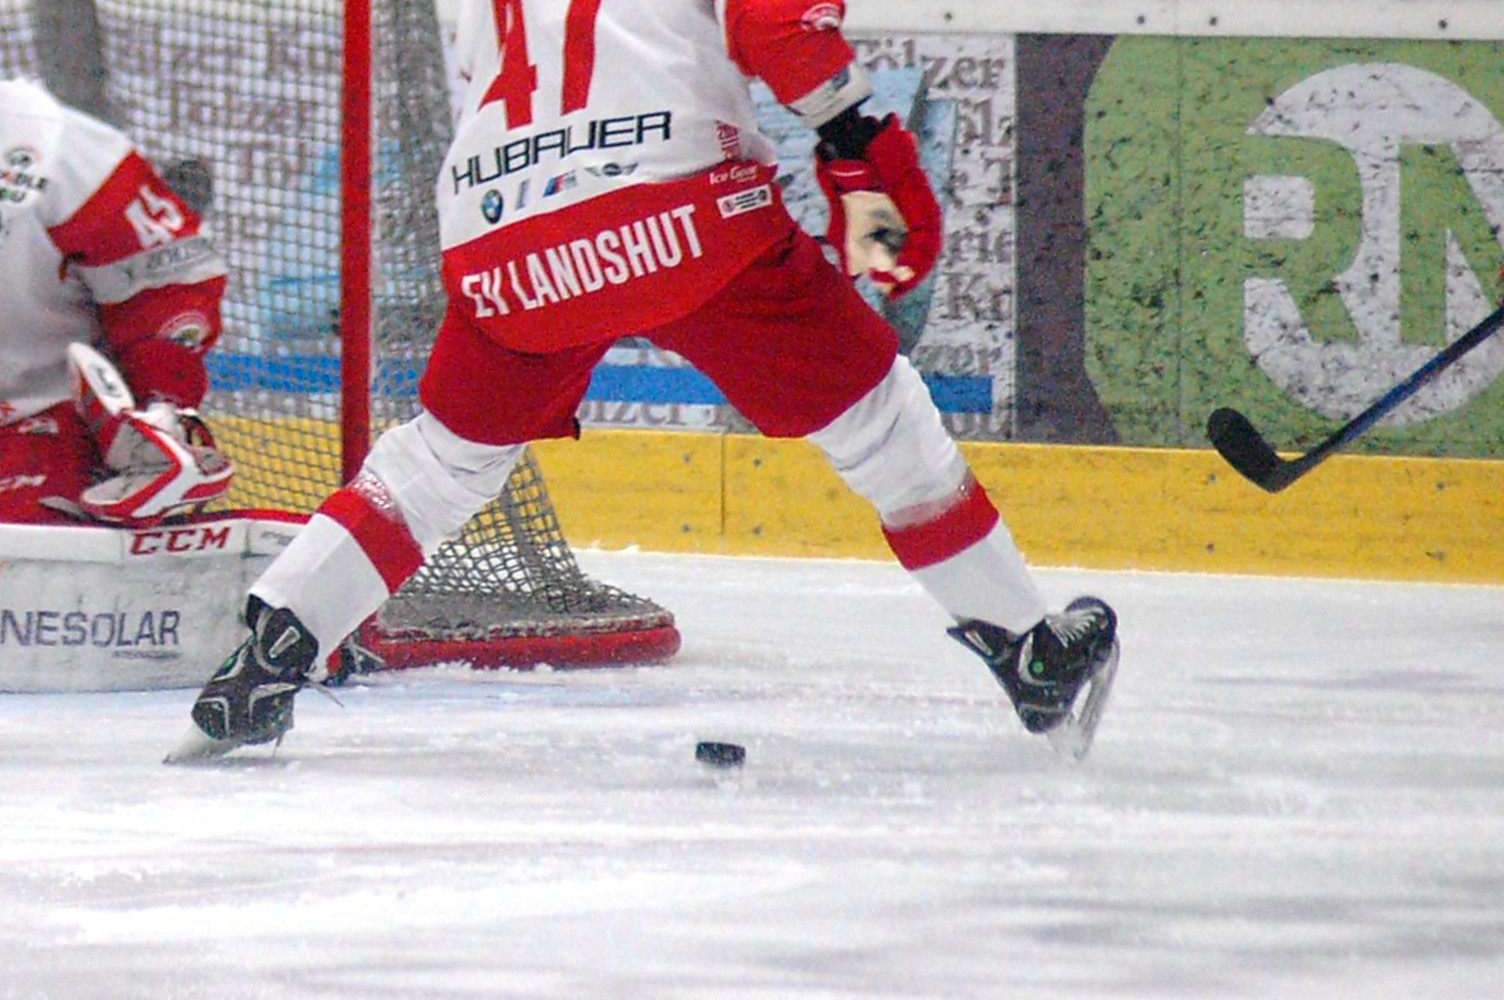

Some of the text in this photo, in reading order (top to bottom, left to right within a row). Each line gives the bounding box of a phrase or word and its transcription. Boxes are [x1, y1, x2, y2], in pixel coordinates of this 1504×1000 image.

[452, 110, 672, 195] HUBAUER
[507, 203, 704, 311] LANDSHUT
[129, 526, 232, 556] CCM
